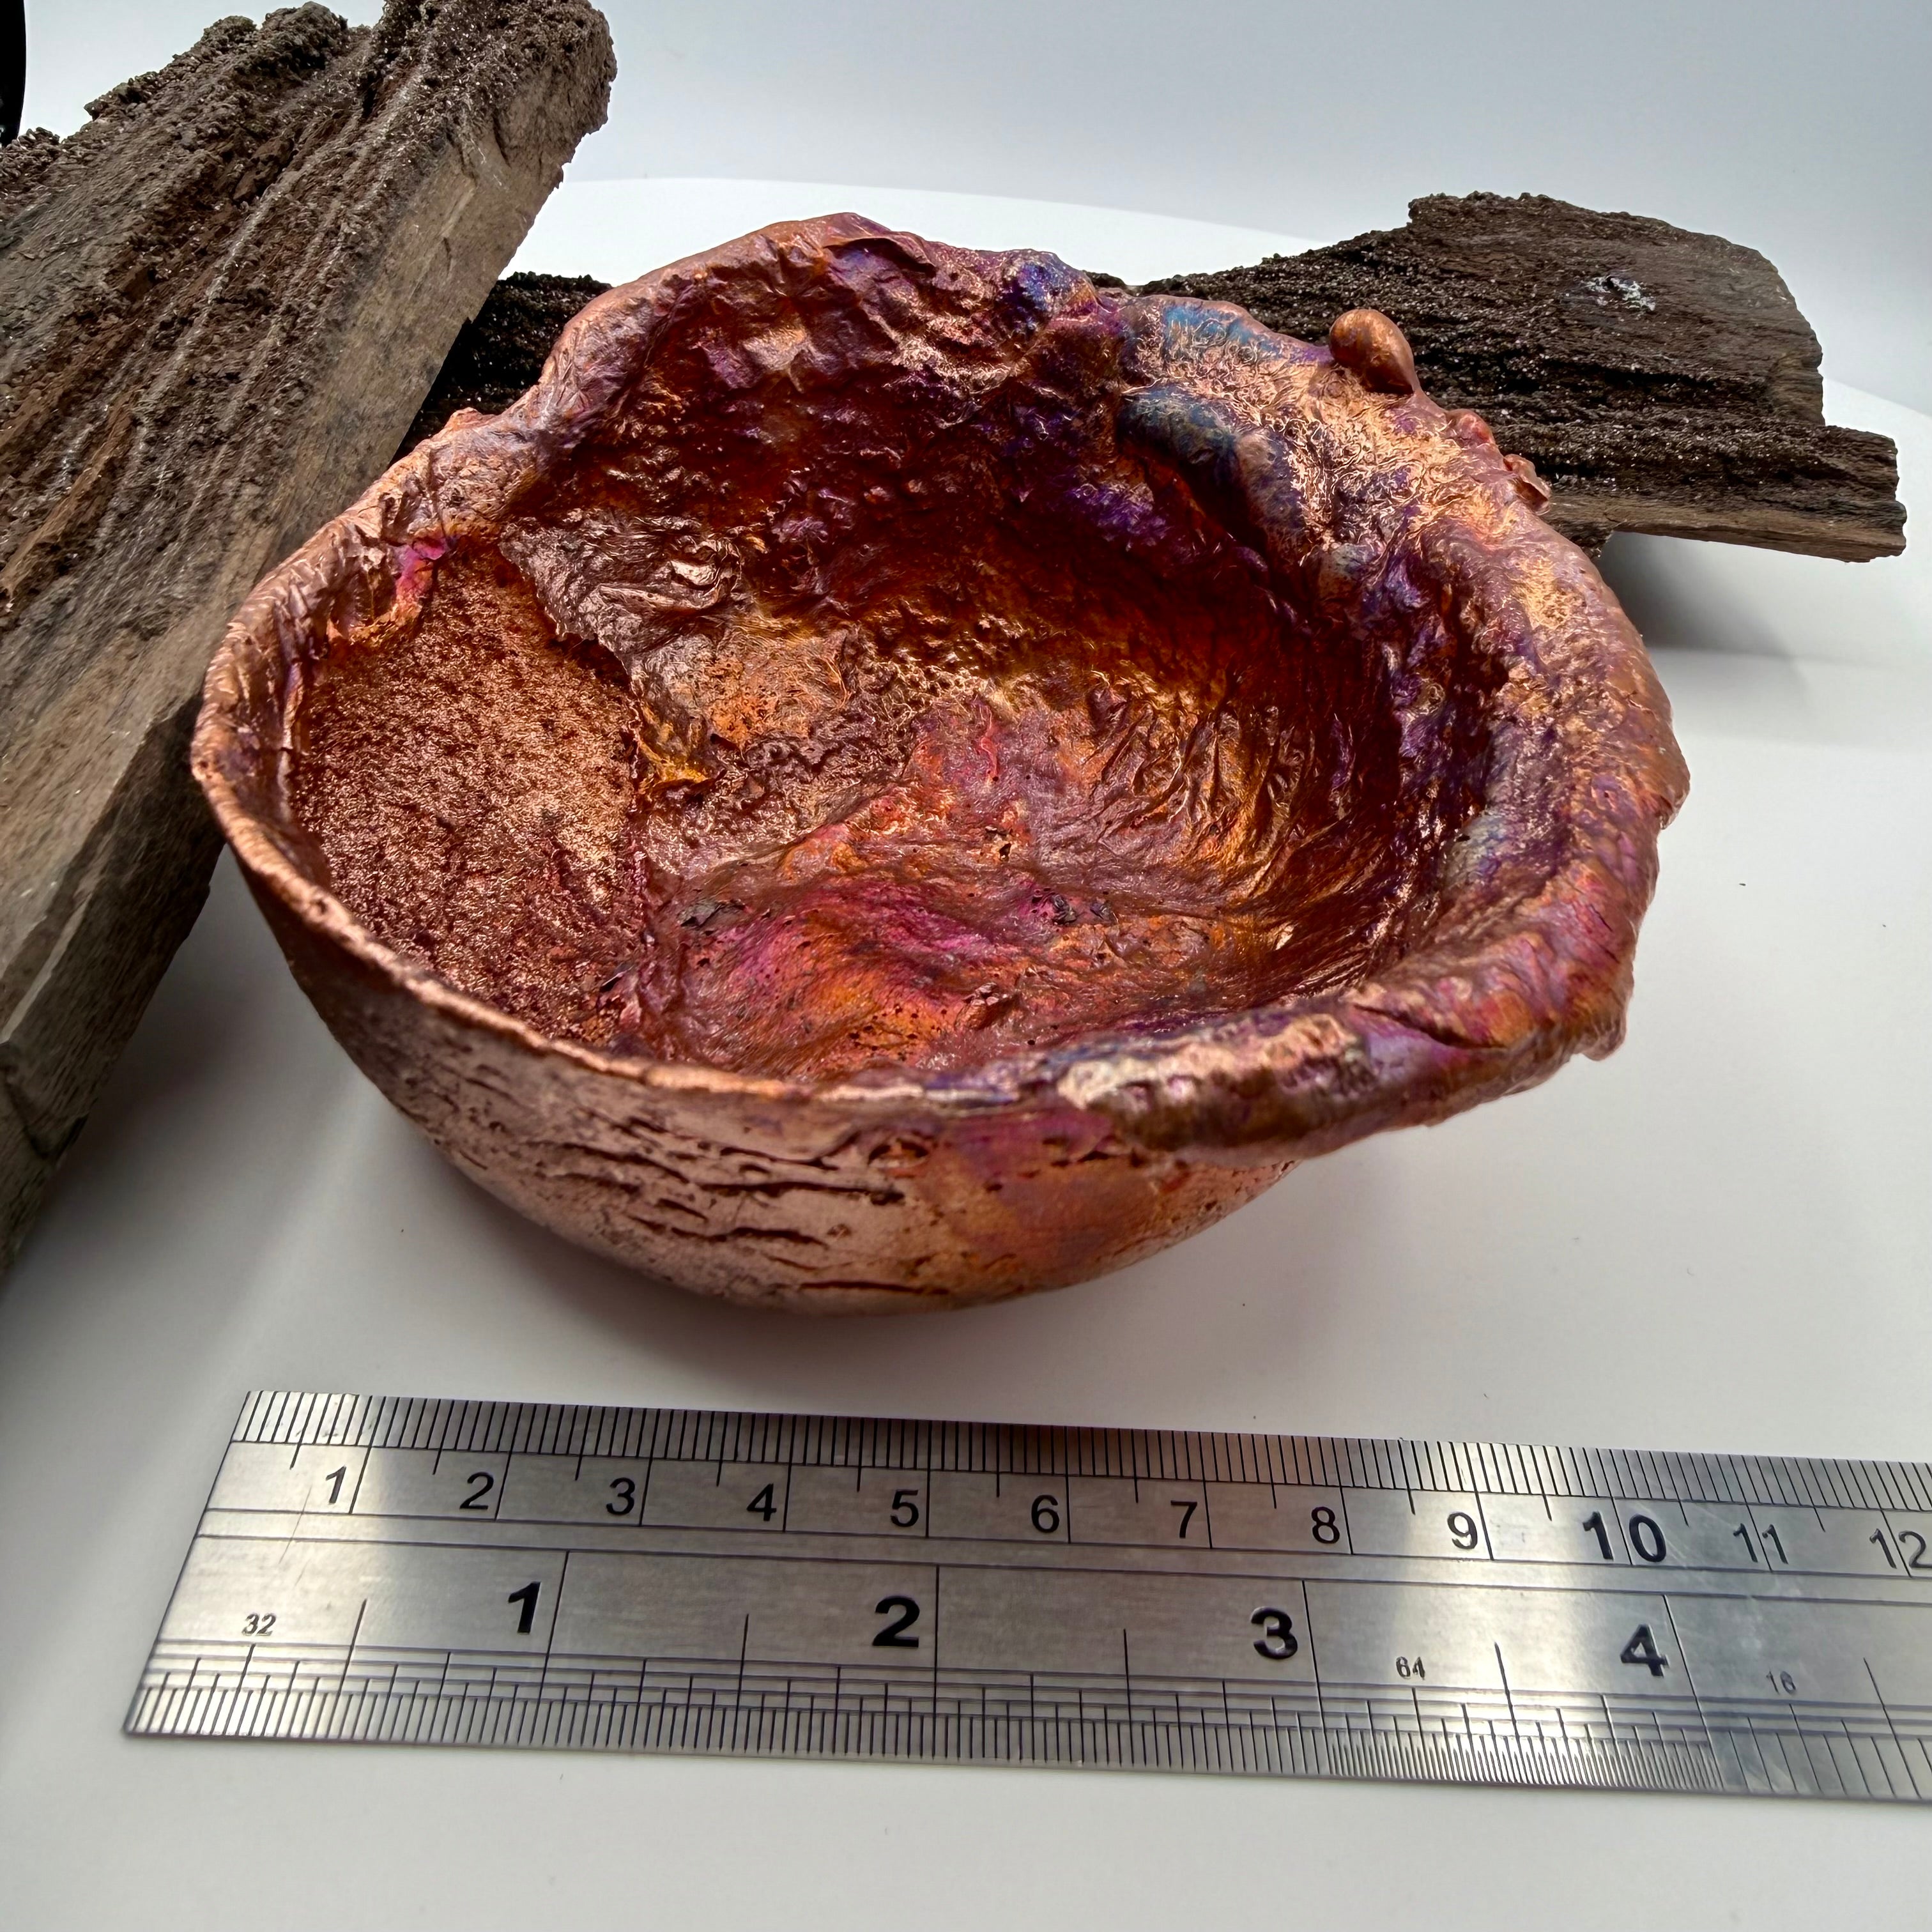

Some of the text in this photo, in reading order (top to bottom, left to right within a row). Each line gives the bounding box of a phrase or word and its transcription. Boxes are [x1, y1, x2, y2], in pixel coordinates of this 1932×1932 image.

[325, 1466, 1932, 1570] 1 2 3 4 5 6 7 8 9 10 11 12
[241, 1613, 277, 1637] 32
[507, 1581, 1669, 1678] 1 2 3 4
[1395, 1656, 1426, 1680] 64
[1765, 1669, 1797, 1694] 16
